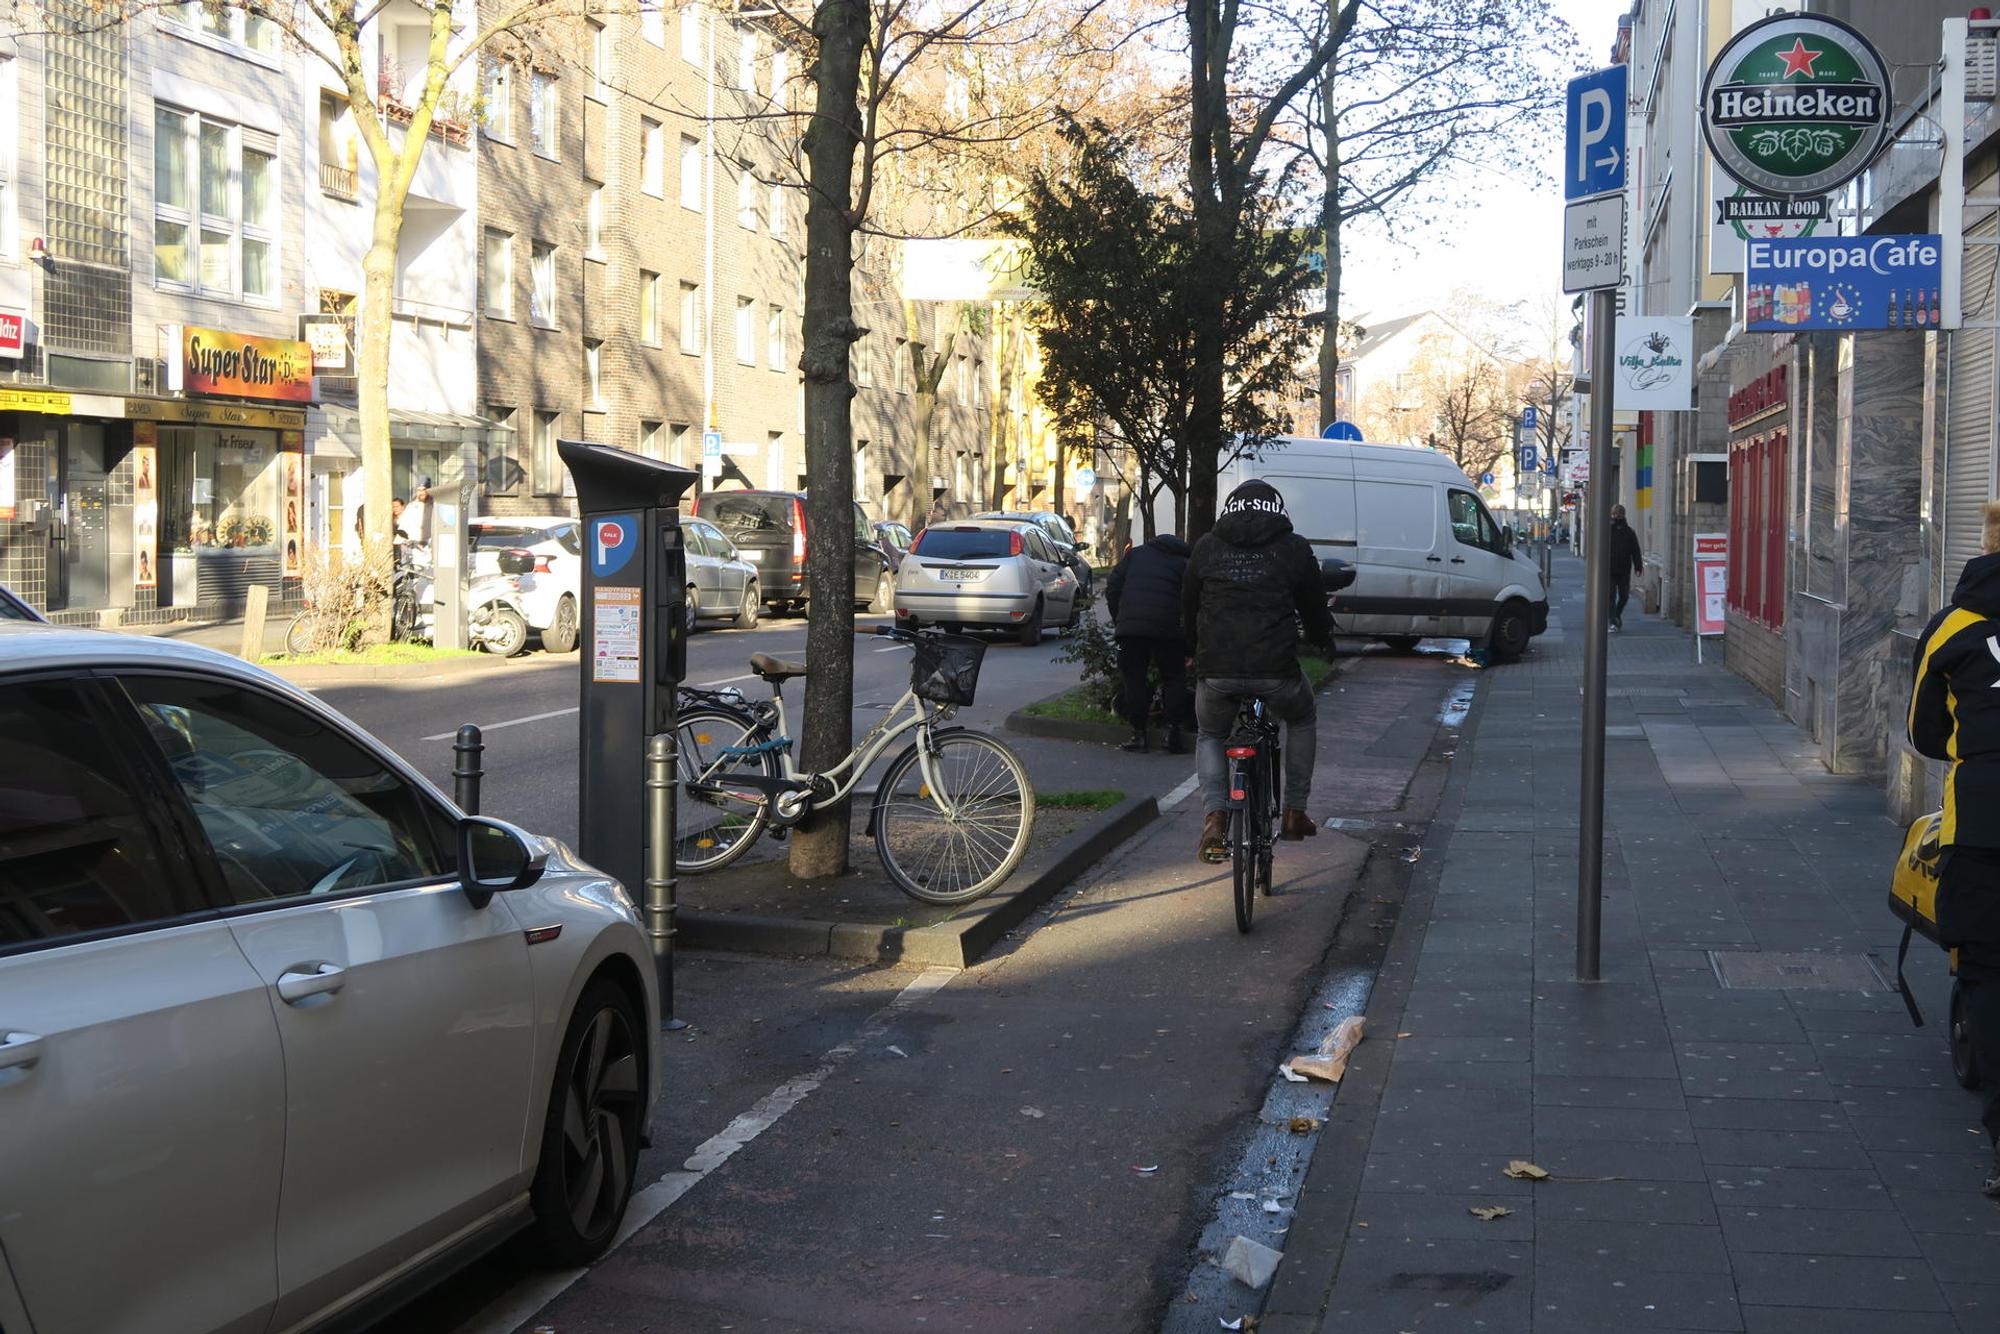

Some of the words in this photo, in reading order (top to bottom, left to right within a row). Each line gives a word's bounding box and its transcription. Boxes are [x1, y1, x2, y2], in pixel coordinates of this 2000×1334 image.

[1718, 88, 1877, 119] Heineken
[1578, 87, 1612, 182] P
[1729, 201, 1781, 217] BALKAN
[1786, 200, 1821, 216] FOOD
[1586, 215, 1597, 230] mit
[1573, 233, 1609, 251] Parkschein
[1567, 257, 1594, 272] werktags
[1594, 253, 1600, 268] 9
[1604, 252, 1613, 267] 20
[1613, 251, 1619, 265] h
[188, 334, 241, 387] Super
[241, 343, 278, 385] Star
[1524, 409, 1533, 426] P
[1524, 449, 1534, 468] P
